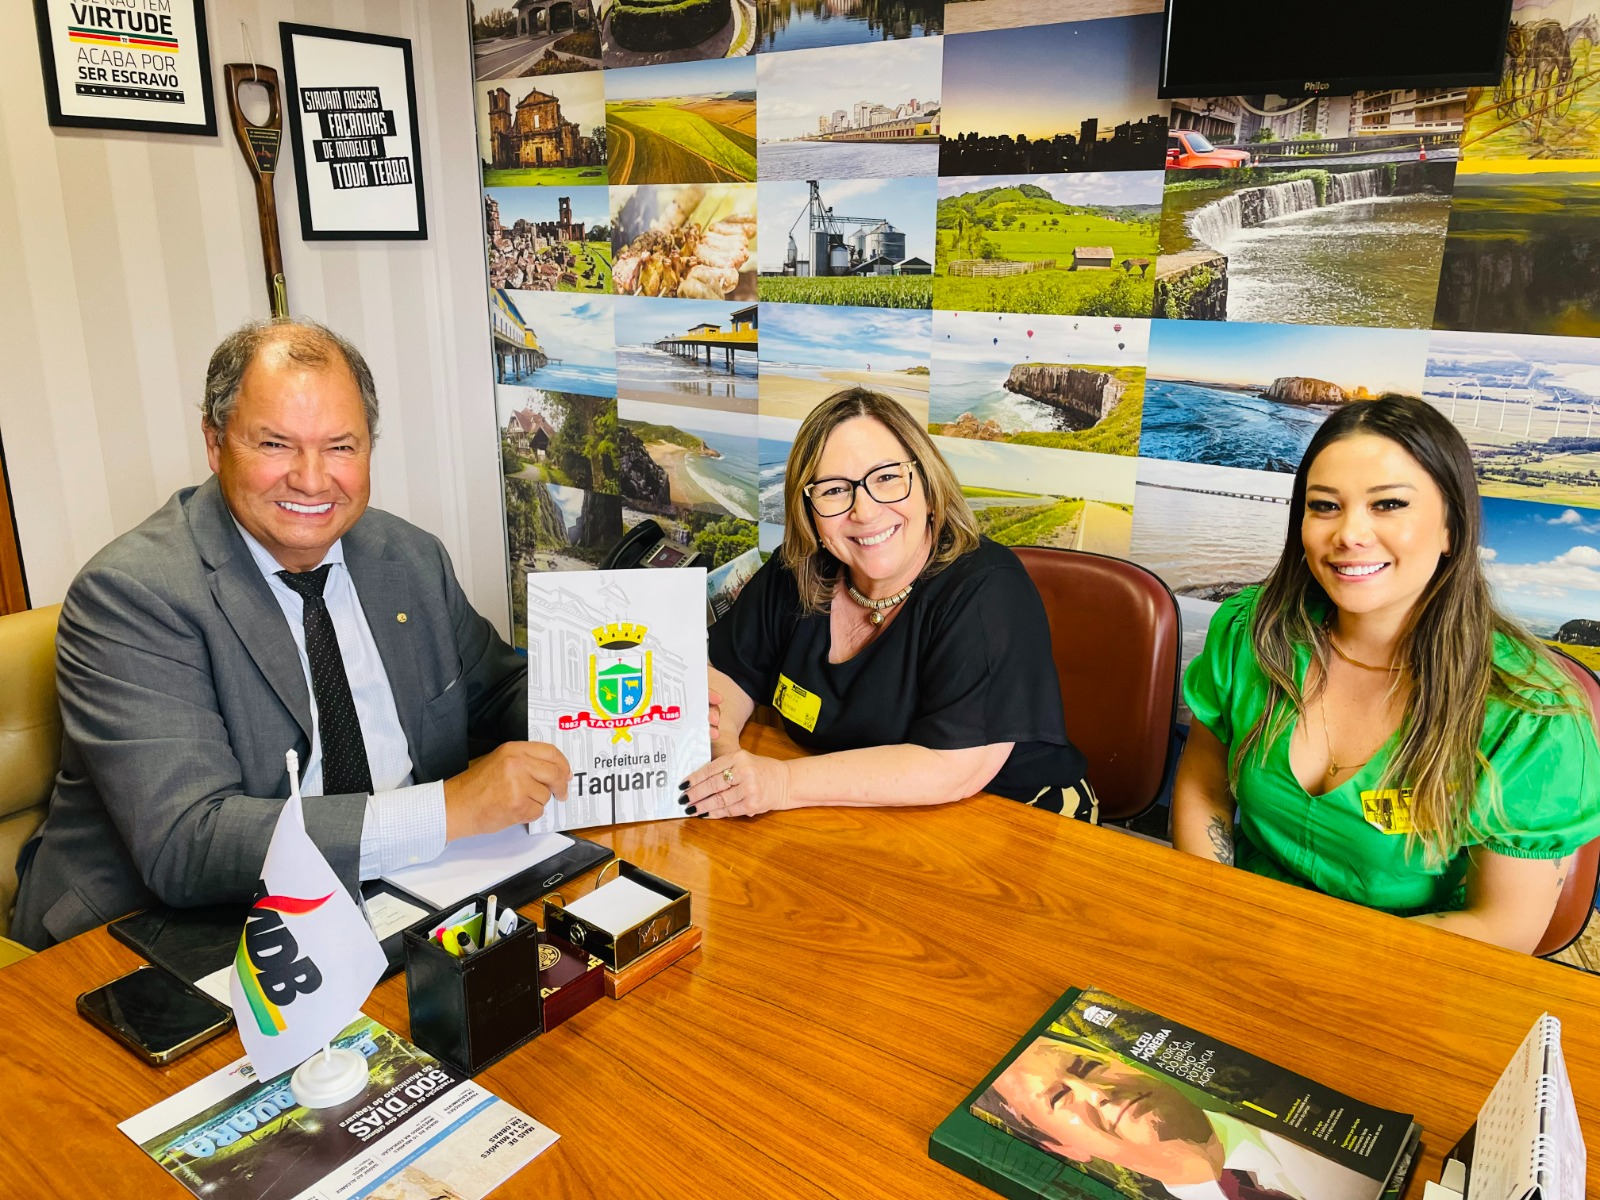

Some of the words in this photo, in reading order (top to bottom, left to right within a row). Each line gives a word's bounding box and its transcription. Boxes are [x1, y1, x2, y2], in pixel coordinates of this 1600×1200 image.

[70, 3, 173, 36] VIRTUDE
[77, 47, 137, 68] ACABA
[142, 54, 176, 72] POR
[78, 66, 108, 82] SER
[112, 69, 178, 88] ESCRAVO
[1304, 82, 1330, 91] Philco
[304, 90, 342, 110] SIRVAM
[344, 90, 378, 109] NOSSAS
[322, 142, 334, 158] DE
[336, 140, 370, 158] MODELO
[372, 140, 378, 156] A
[333, 162, 368, 188] TODA
[370, 159, 409, 185] TERRA
[560, 721, 579, 729] 1882
[589, 715, 651, 728] TAQUARA
[594, 754, 650, 769] Prefeitura
[654, 751, 666, 763] de
[574, 769, 668, 806] Taquara
[1090, 1009, 1112, 1025] FPA
[1129, 1031, 1153, 1056] ALCEU
[1139, 1028, 1171, 1061] MOREIRA
[1158, 1040, 1181, 1063] FORÇA
[1164, 1060, 1179, 1072] DO
[1172, 1040, 1195, 1062] BRASIL
[1175, 1055, 1196, 1076] COMO
[1185, 1049, 1215, 1081] POTÊNCIA
[420, 1064, 433, 1073] do
[1196, 1066, 1215, 1086] AGRO
[382, 1070, 424, 1098] Município
[404, 1069, 448, 1098] 500
[424, 1077, 454, 1098] Prestação
[371, 1096, 384, 1106] de
[396, 1101, 418, 1117] contas
[338, 1104, 374, 1127] Taquara
[347, 1096, 407, 1137] DIAS
[384, 1115, 397, 1126] dos
[509, 1117, 522, 1126] EM
[360, 1124, 386, 1142] últimos
[488, 1124, 511, 1142] OBRAS
[507, 1137, 518, 1146] DE
[508, 1128, 519, 1136] 14
[516, 1125, 534, 1138] MAIS
[480, 1134, 510, 1158] MILHÕES
